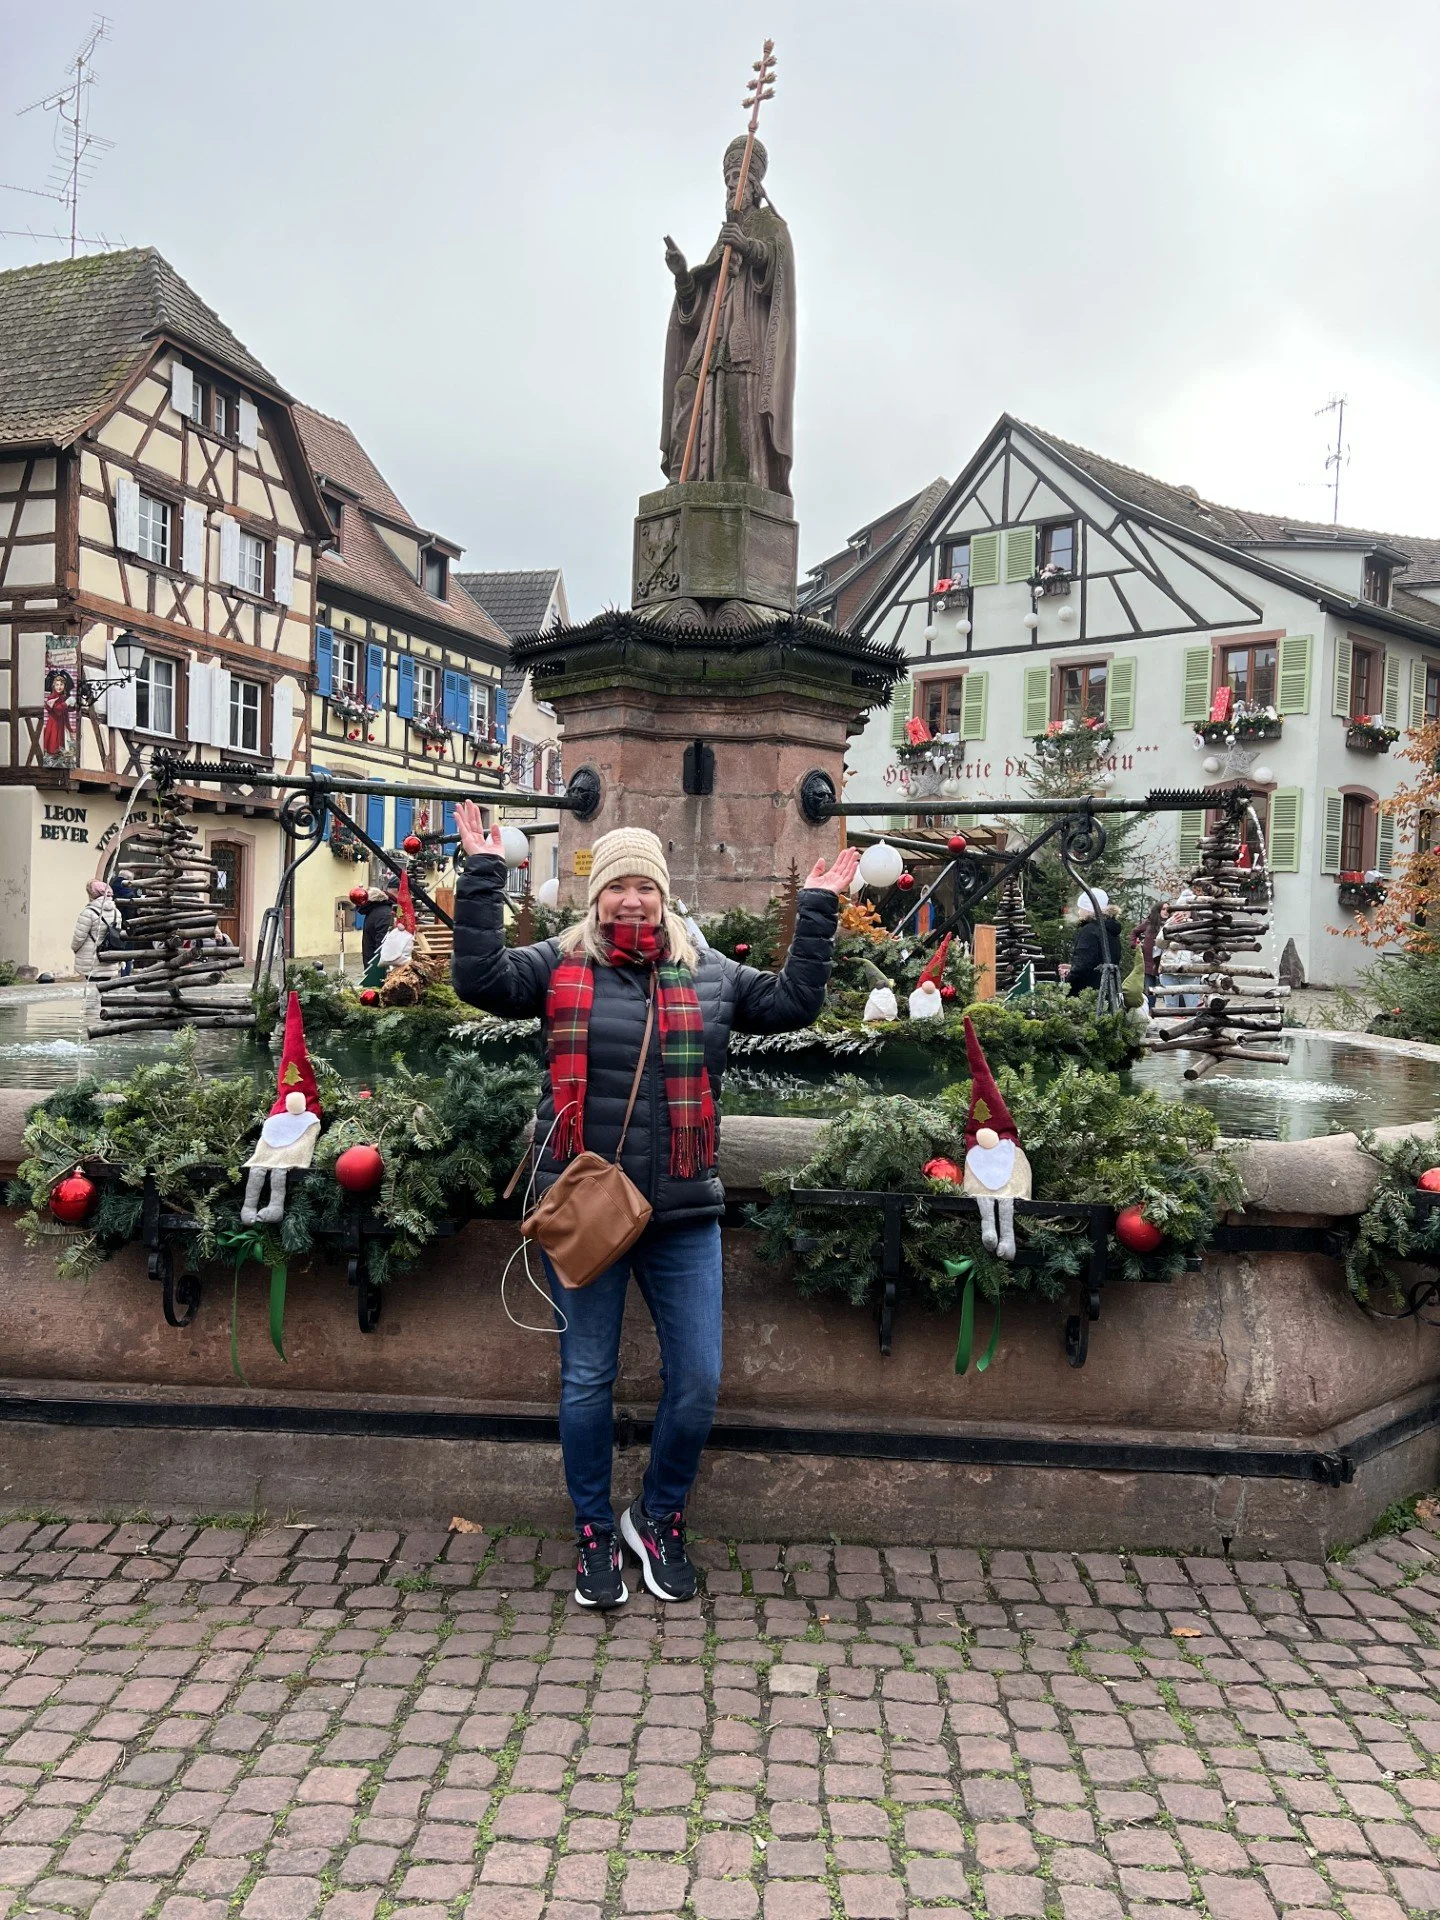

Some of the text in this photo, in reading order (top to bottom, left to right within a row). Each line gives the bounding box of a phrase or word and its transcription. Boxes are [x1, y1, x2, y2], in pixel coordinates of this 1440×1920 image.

[883, 758, 992, 787] Hostllerie
[1004, 756, 1029, 778] du
[44, 804, 88, 823] LEON
[40, 824, 89, 843] BEYER
[95, 822, 120, 851] VINS
